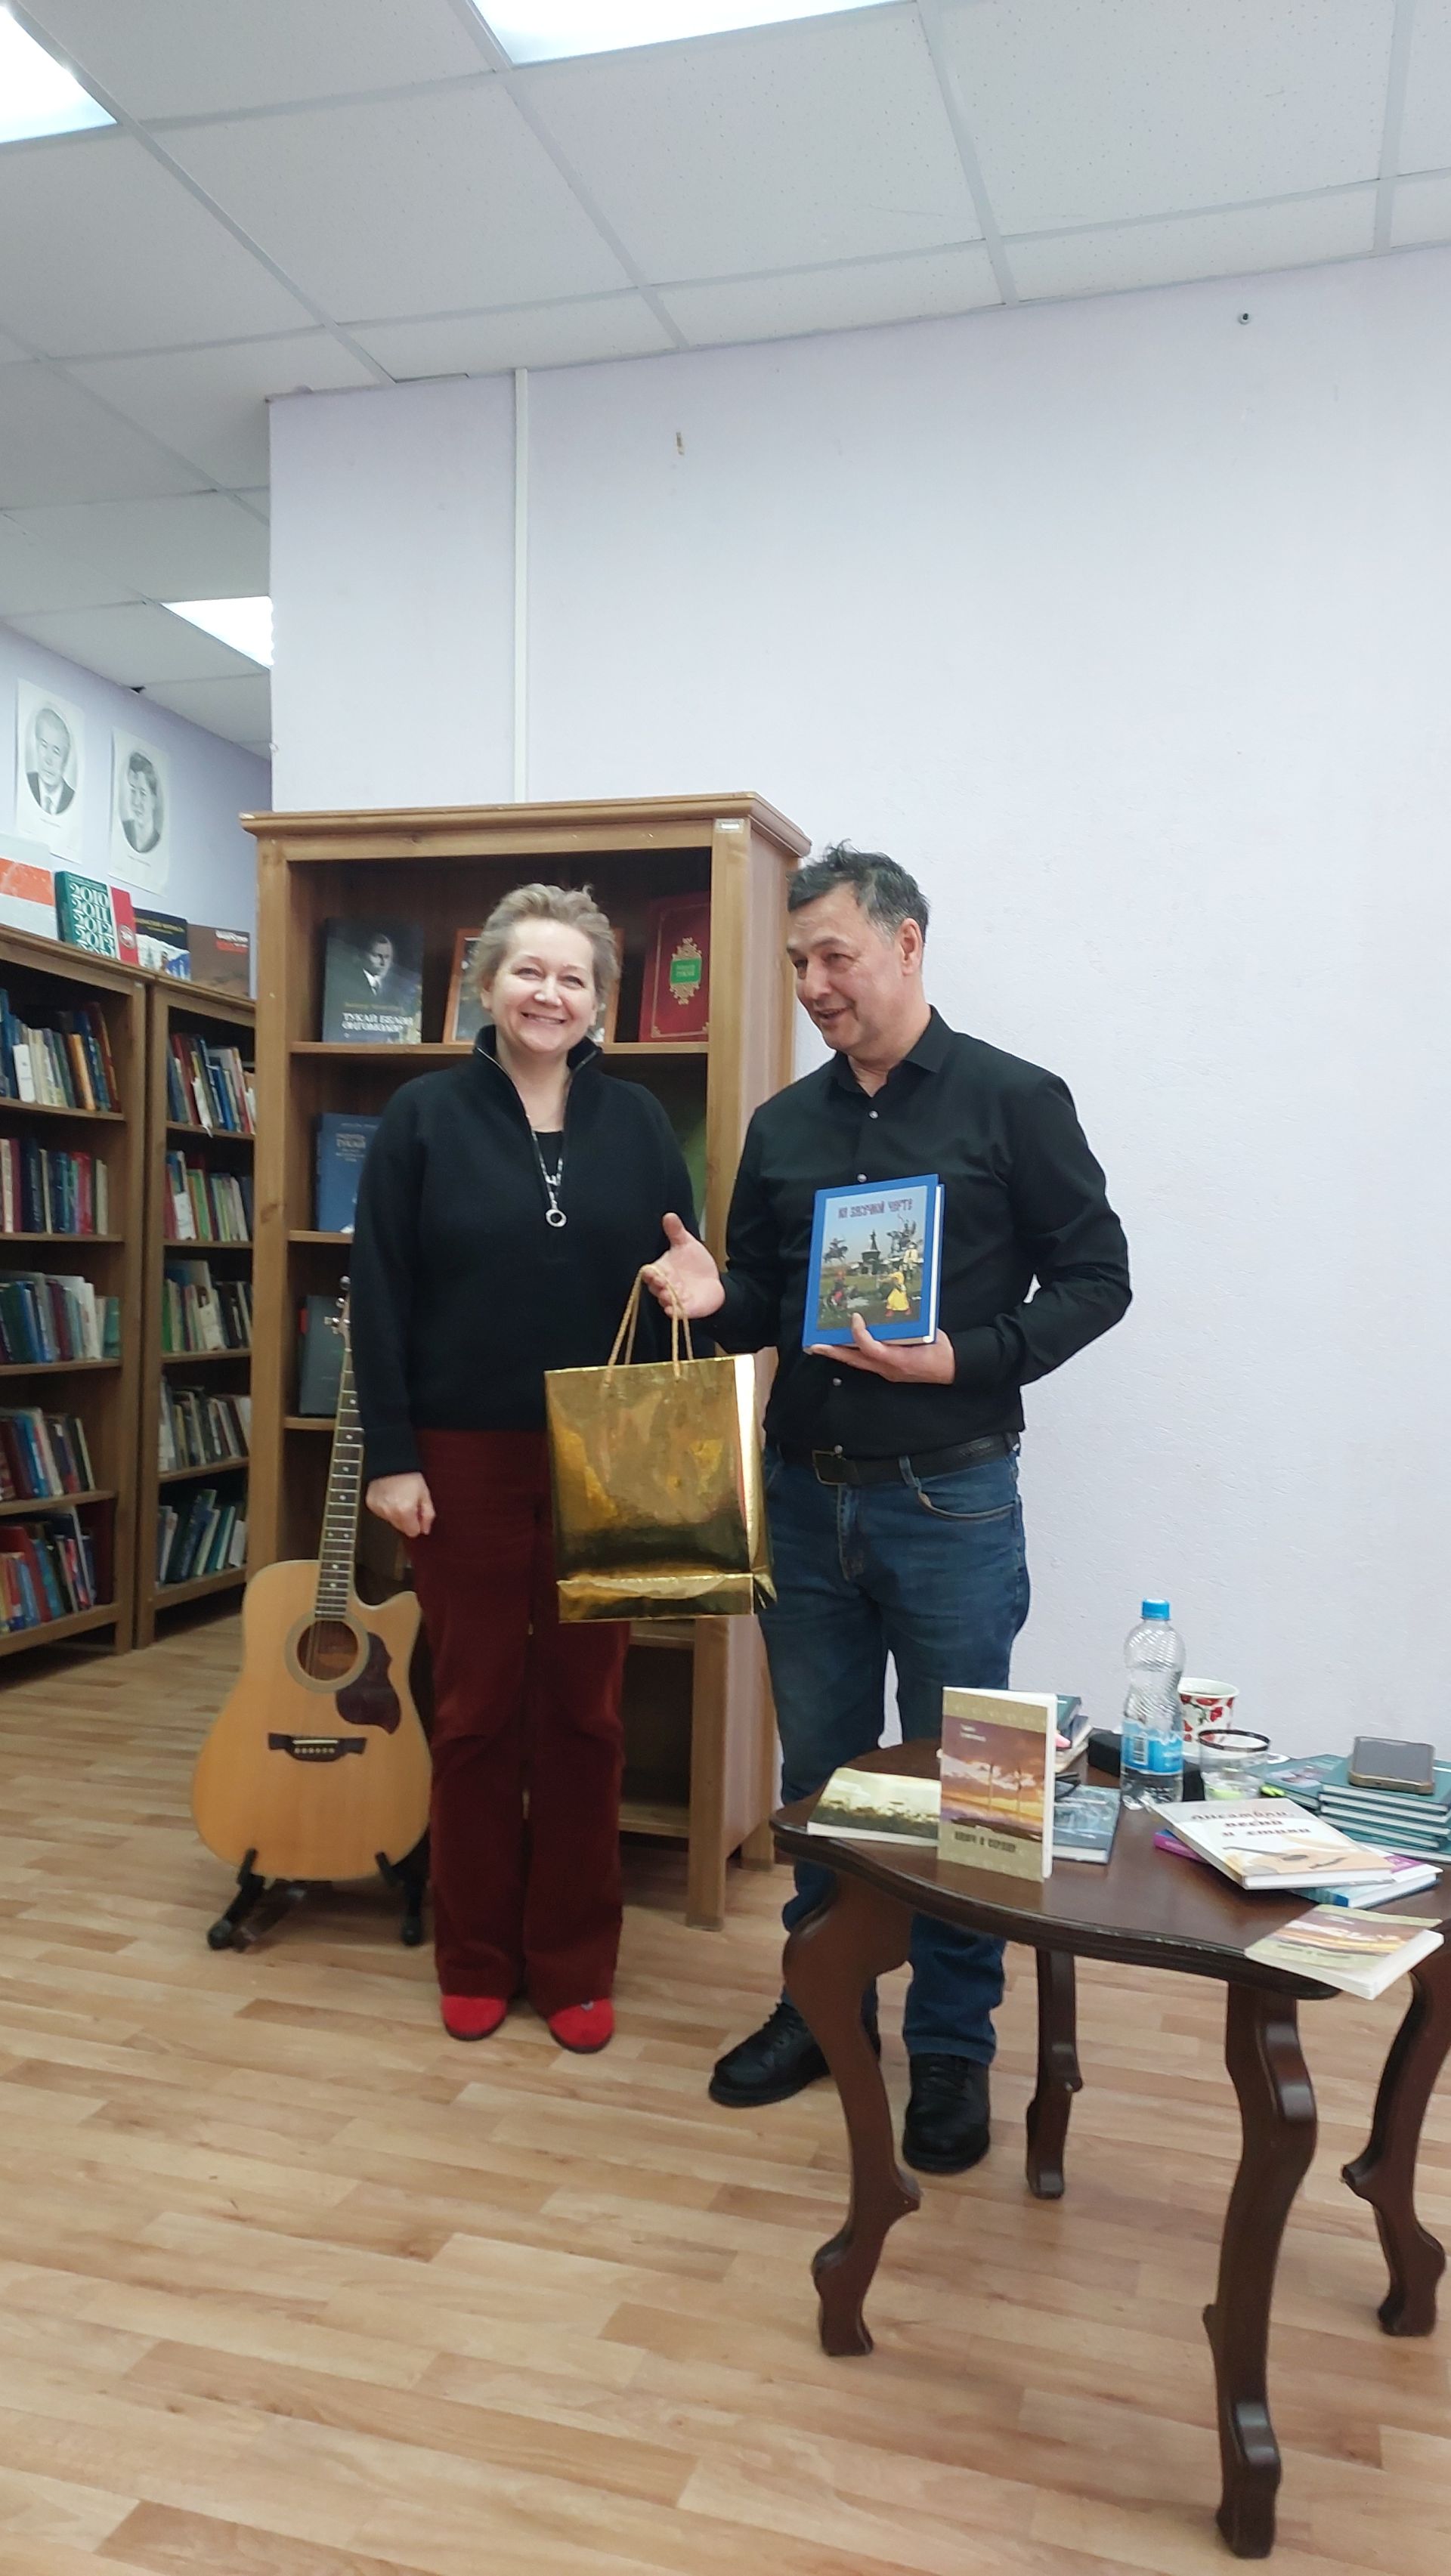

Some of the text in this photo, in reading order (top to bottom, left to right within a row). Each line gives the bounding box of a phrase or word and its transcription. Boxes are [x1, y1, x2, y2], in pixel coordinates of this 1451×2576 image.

[69, 883, 110, 909] 2010
[71, 897, 111, 923] 2011
[73, 912, 113, 938] 2012
